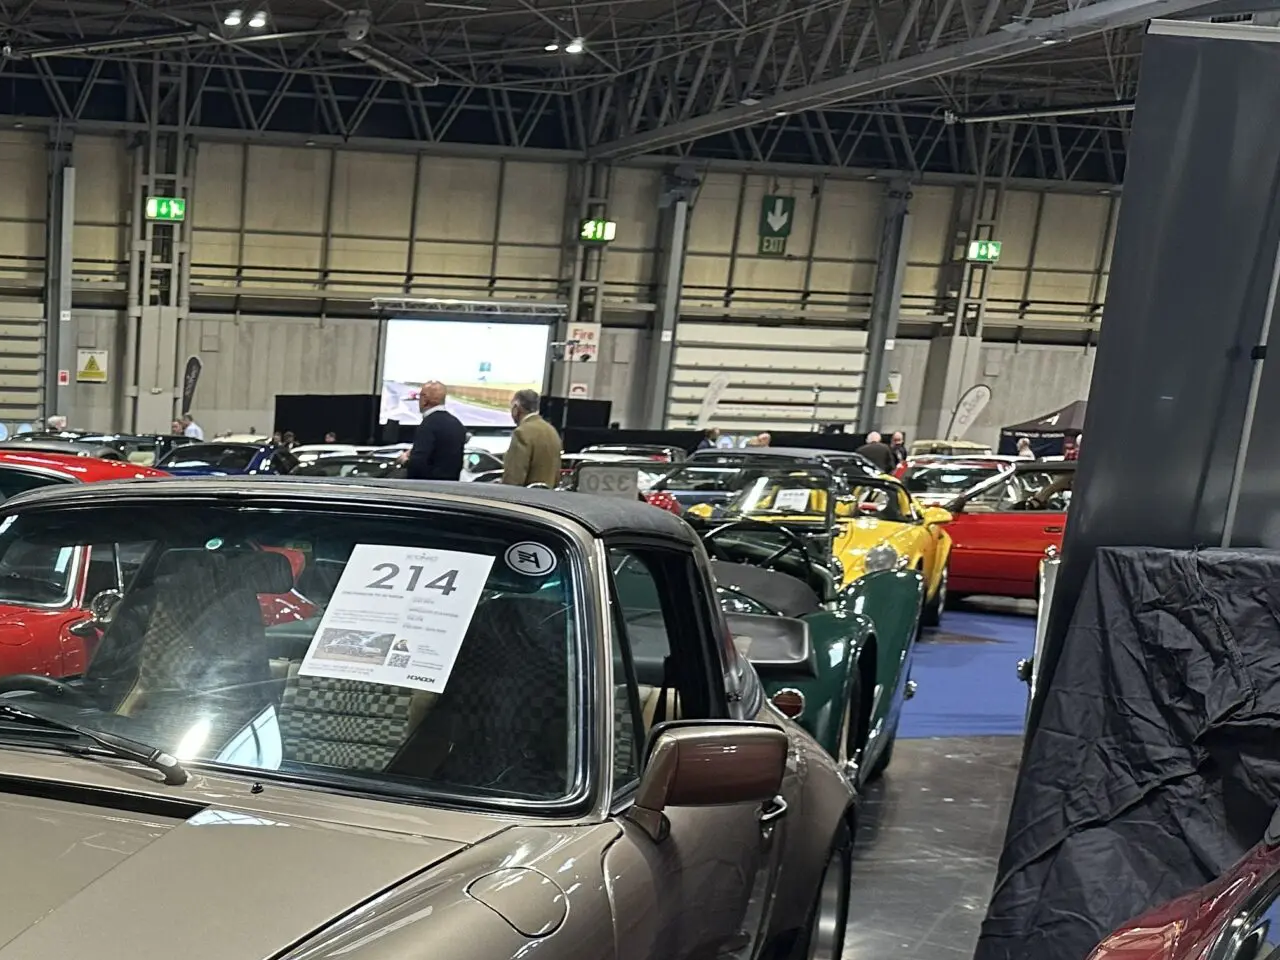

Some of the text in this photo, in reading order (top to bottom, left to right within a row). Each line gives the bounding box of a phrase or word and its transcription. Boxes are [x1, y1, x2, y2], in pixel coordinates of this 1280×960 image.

[763, 237, 785, 252] EXIT
[573, 329, 594, 340] Fire
[365, 563, 459, 596] 214
